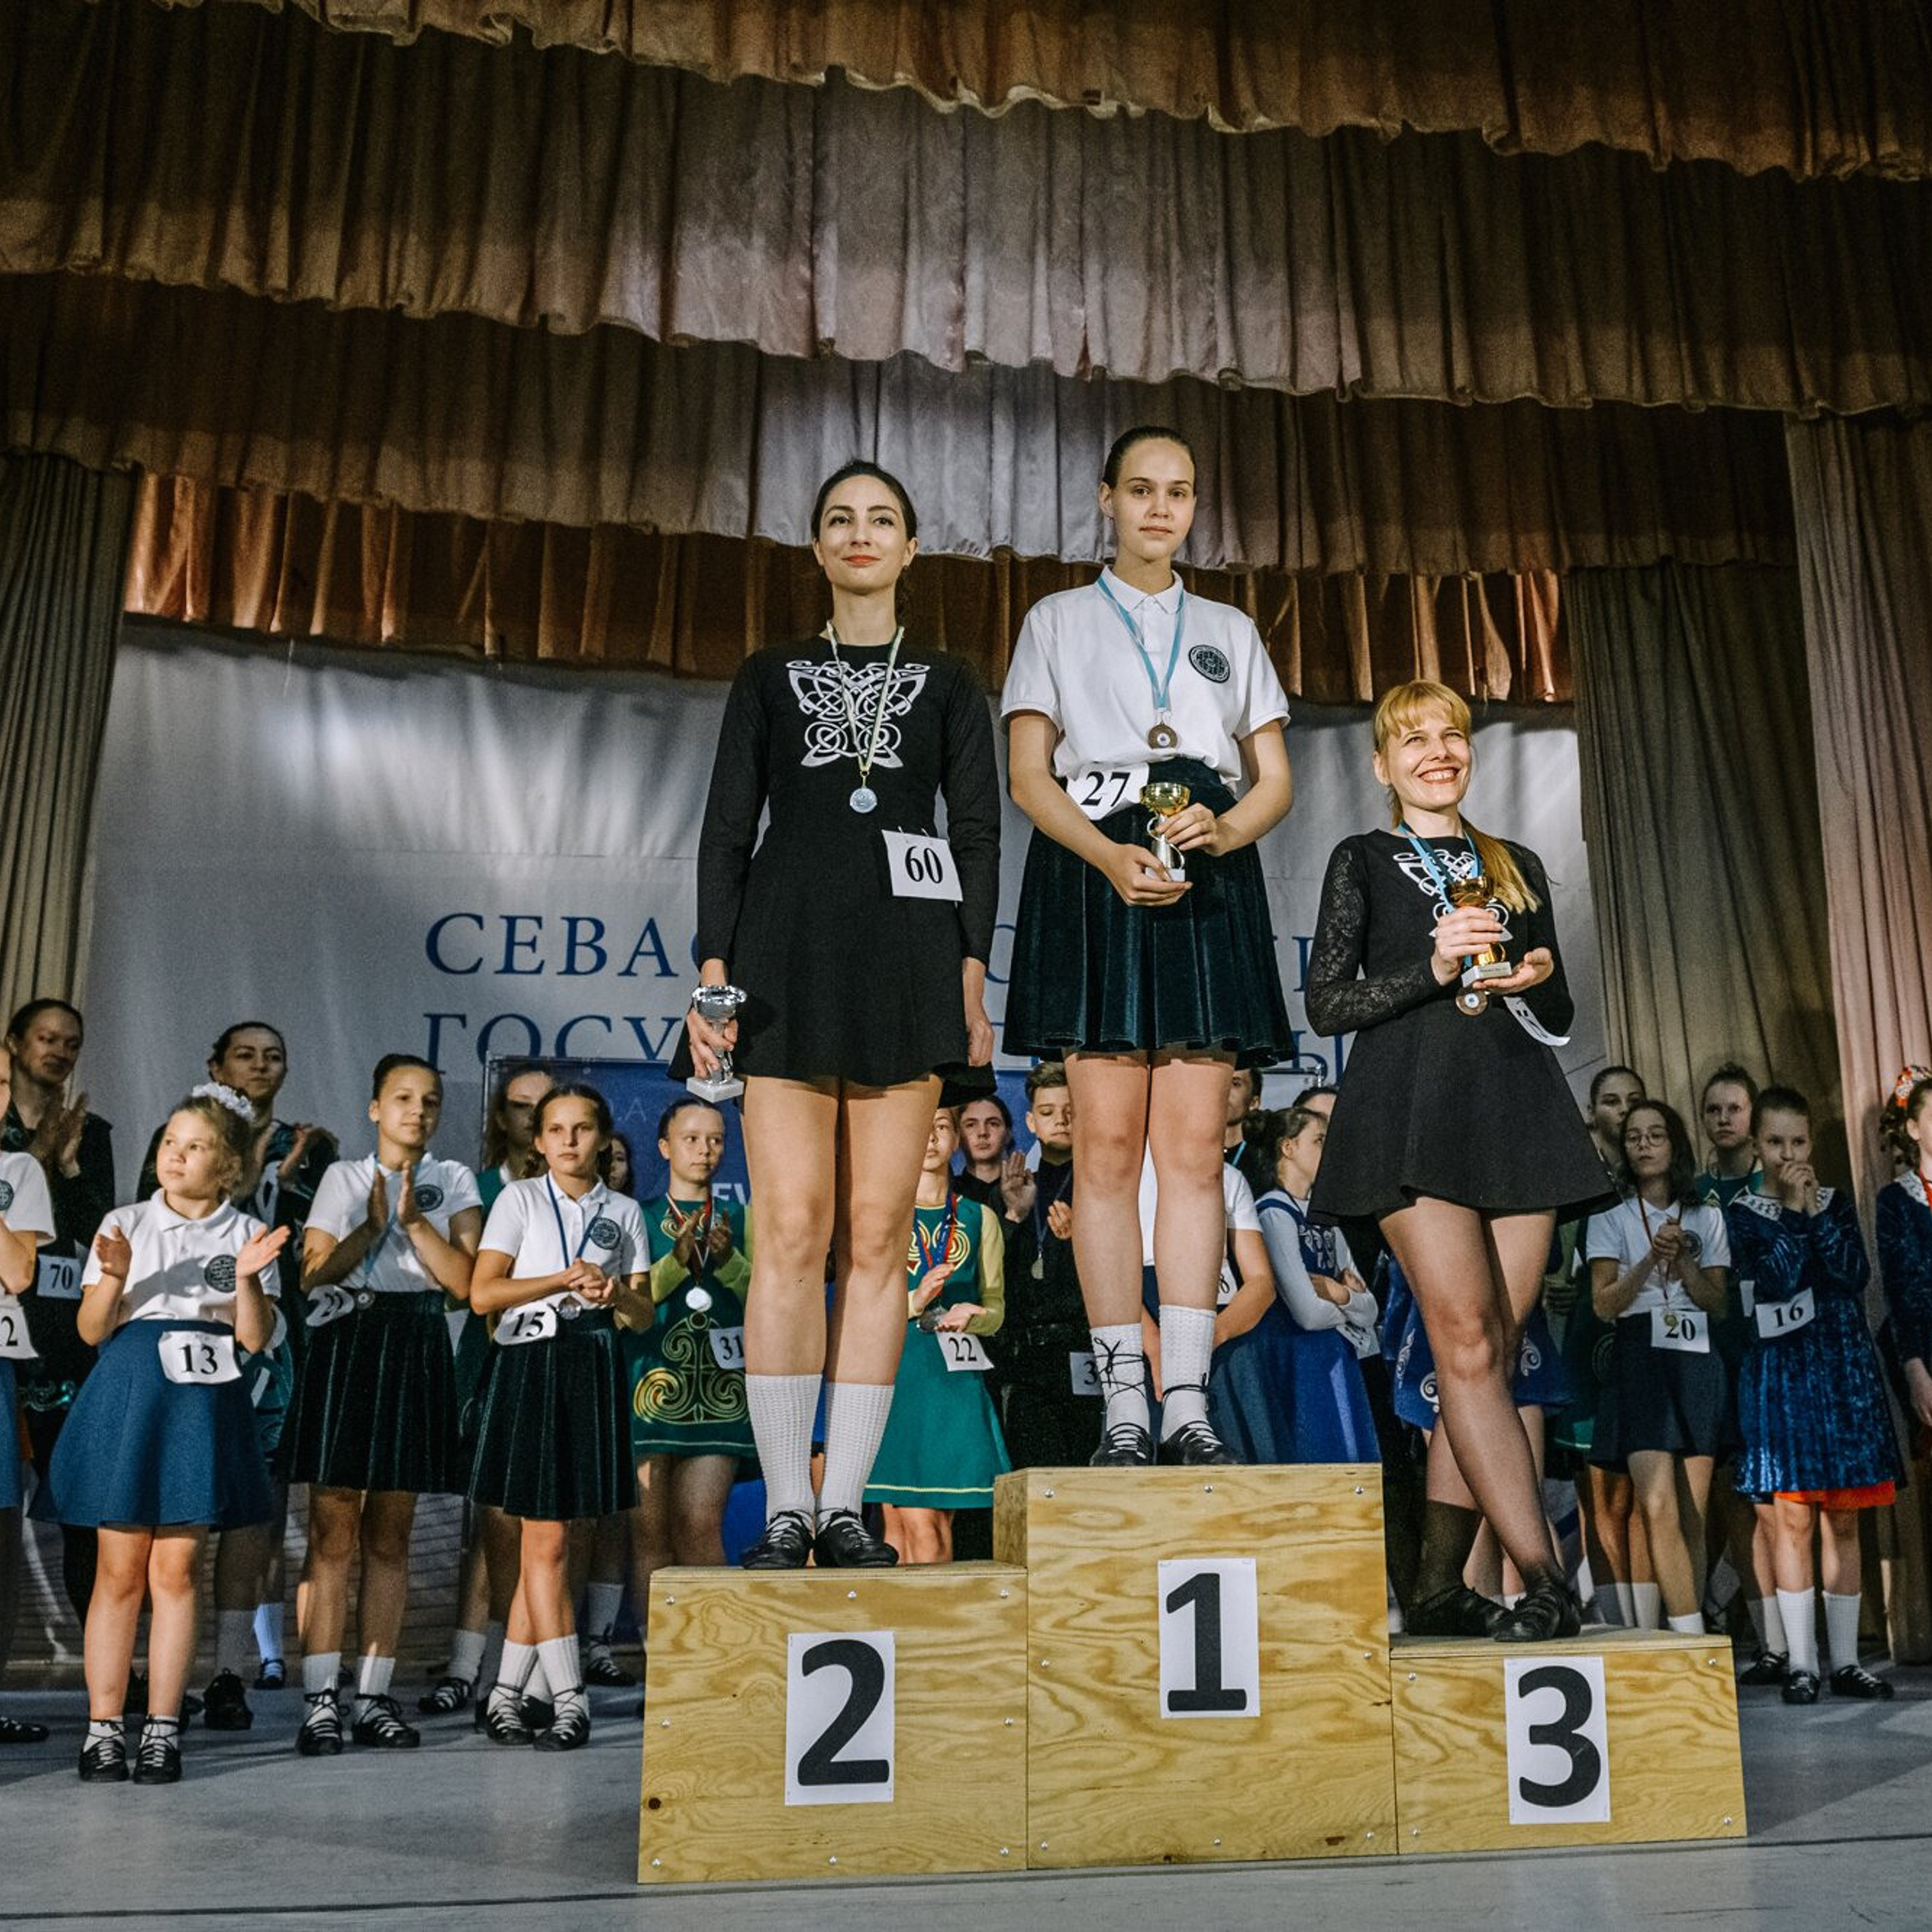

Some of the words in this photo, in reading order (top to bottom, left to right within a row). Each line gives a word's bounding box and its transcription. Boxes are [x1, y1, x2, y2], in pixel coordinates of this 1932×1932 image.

[1081, 771, 1131, 807] 27
[905, 845, 943, 884] 60
[425, 912, 700, 977] СЕВА
[423, 1013, 683, 1075] ГОСУ
[50, 1263, 74, 1290] 70
[0, 1315, 18, 1346] 2
[512, 1311, 546, 1337] 15
[1774, 1300, 1803, 1327] 16
[177, 1343, 219, 1375] 13
[719, 1334, 745, 1360] 31
[948, 1337, 978, 1361] 22
[1165, 1572, 1247, 1712] 1
[797, 1638, 891, 1786] 2
[1518, 1665, 1601, 1807] 3
